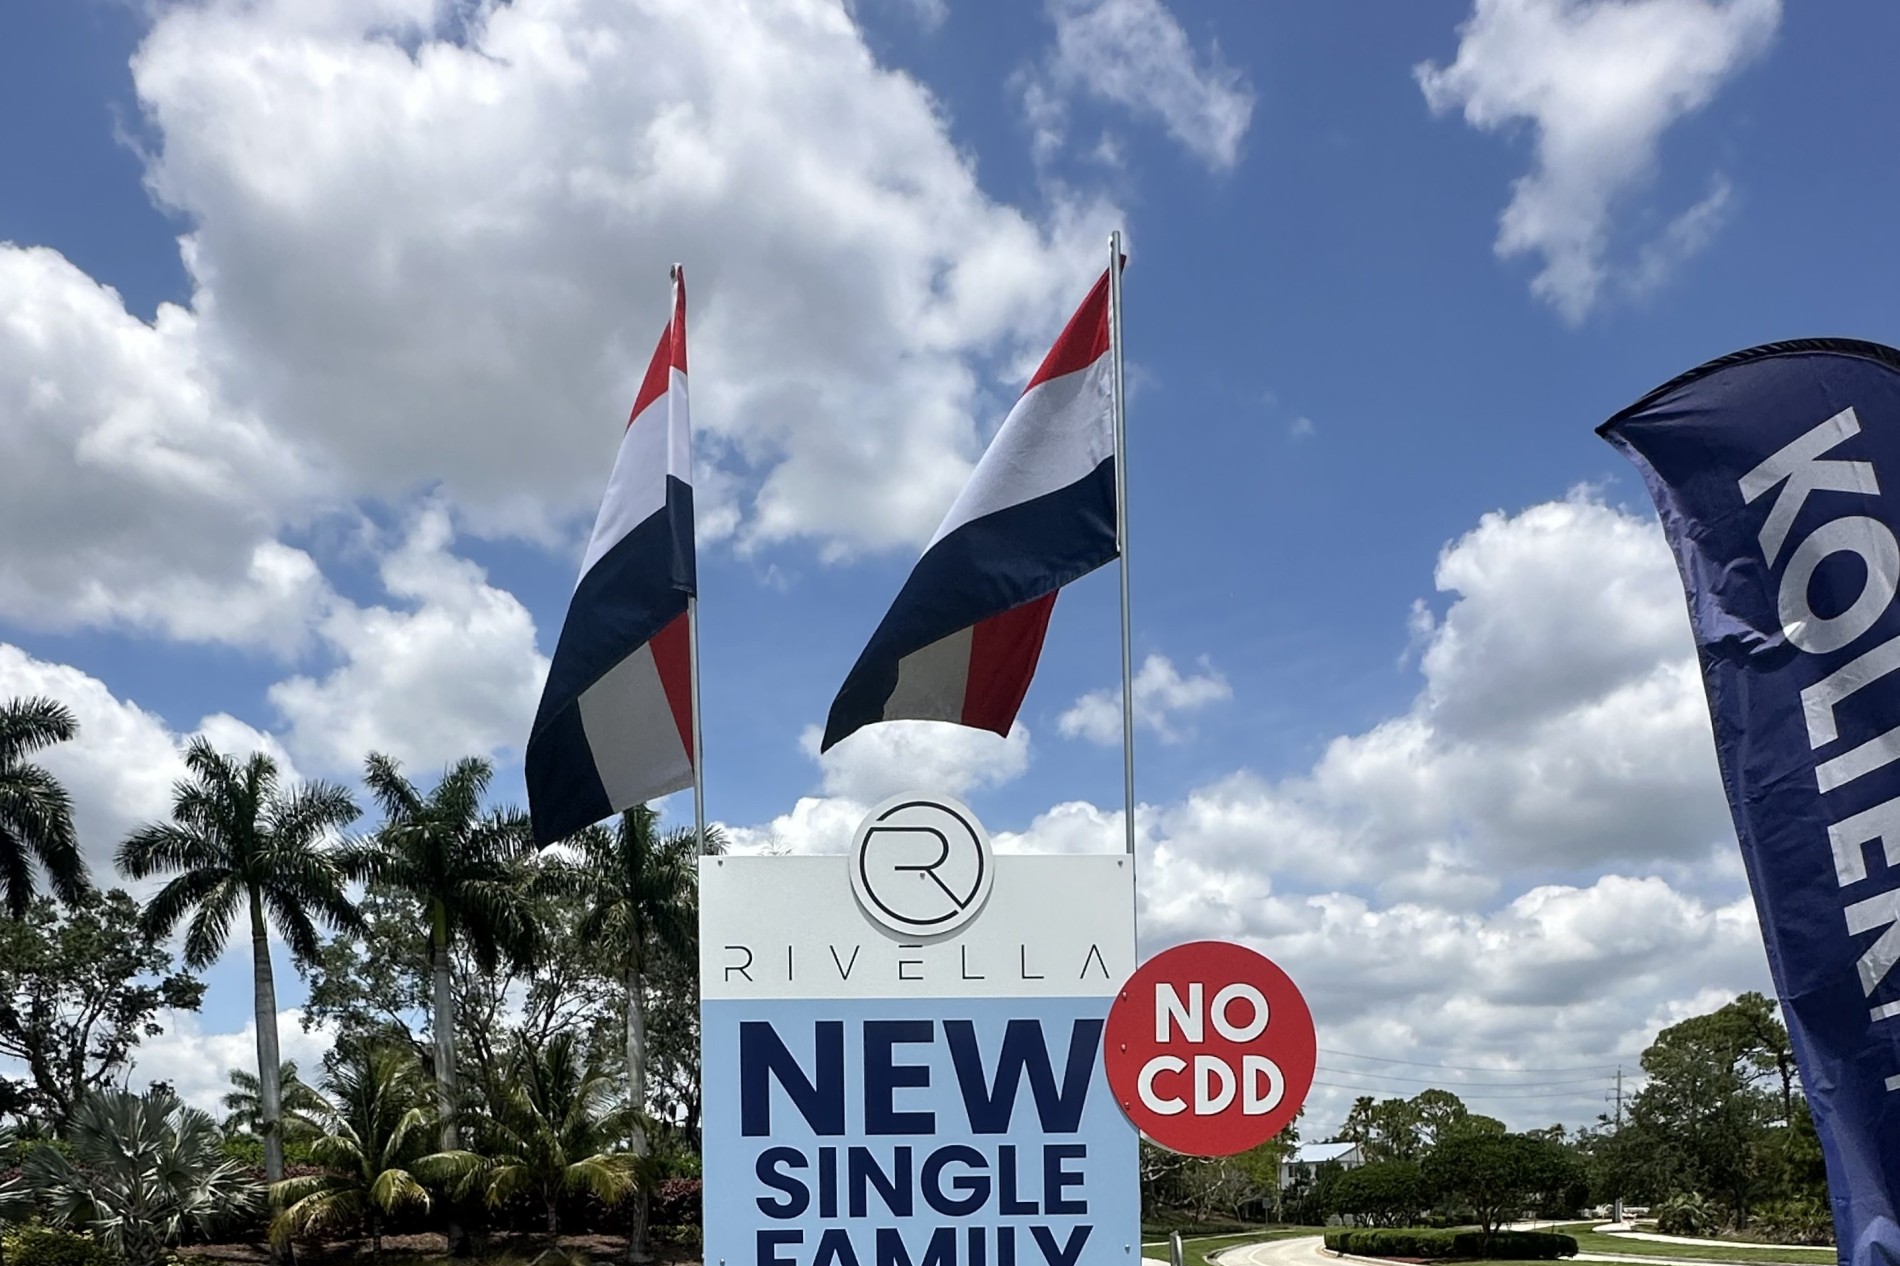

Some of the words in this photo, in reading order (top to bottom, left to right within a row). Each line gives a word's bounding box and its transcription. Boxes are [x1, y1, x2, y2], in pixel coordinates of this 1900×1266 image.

[724, 944, 1111, 982] RIVELLA
[1154, 982, 1270, 1044] NO
[739, 1018, 1106, 1138] NEW
[1136, 1054, 1286, 1116] CDD
[754, 1143, 1089, 1220] SINGLE
